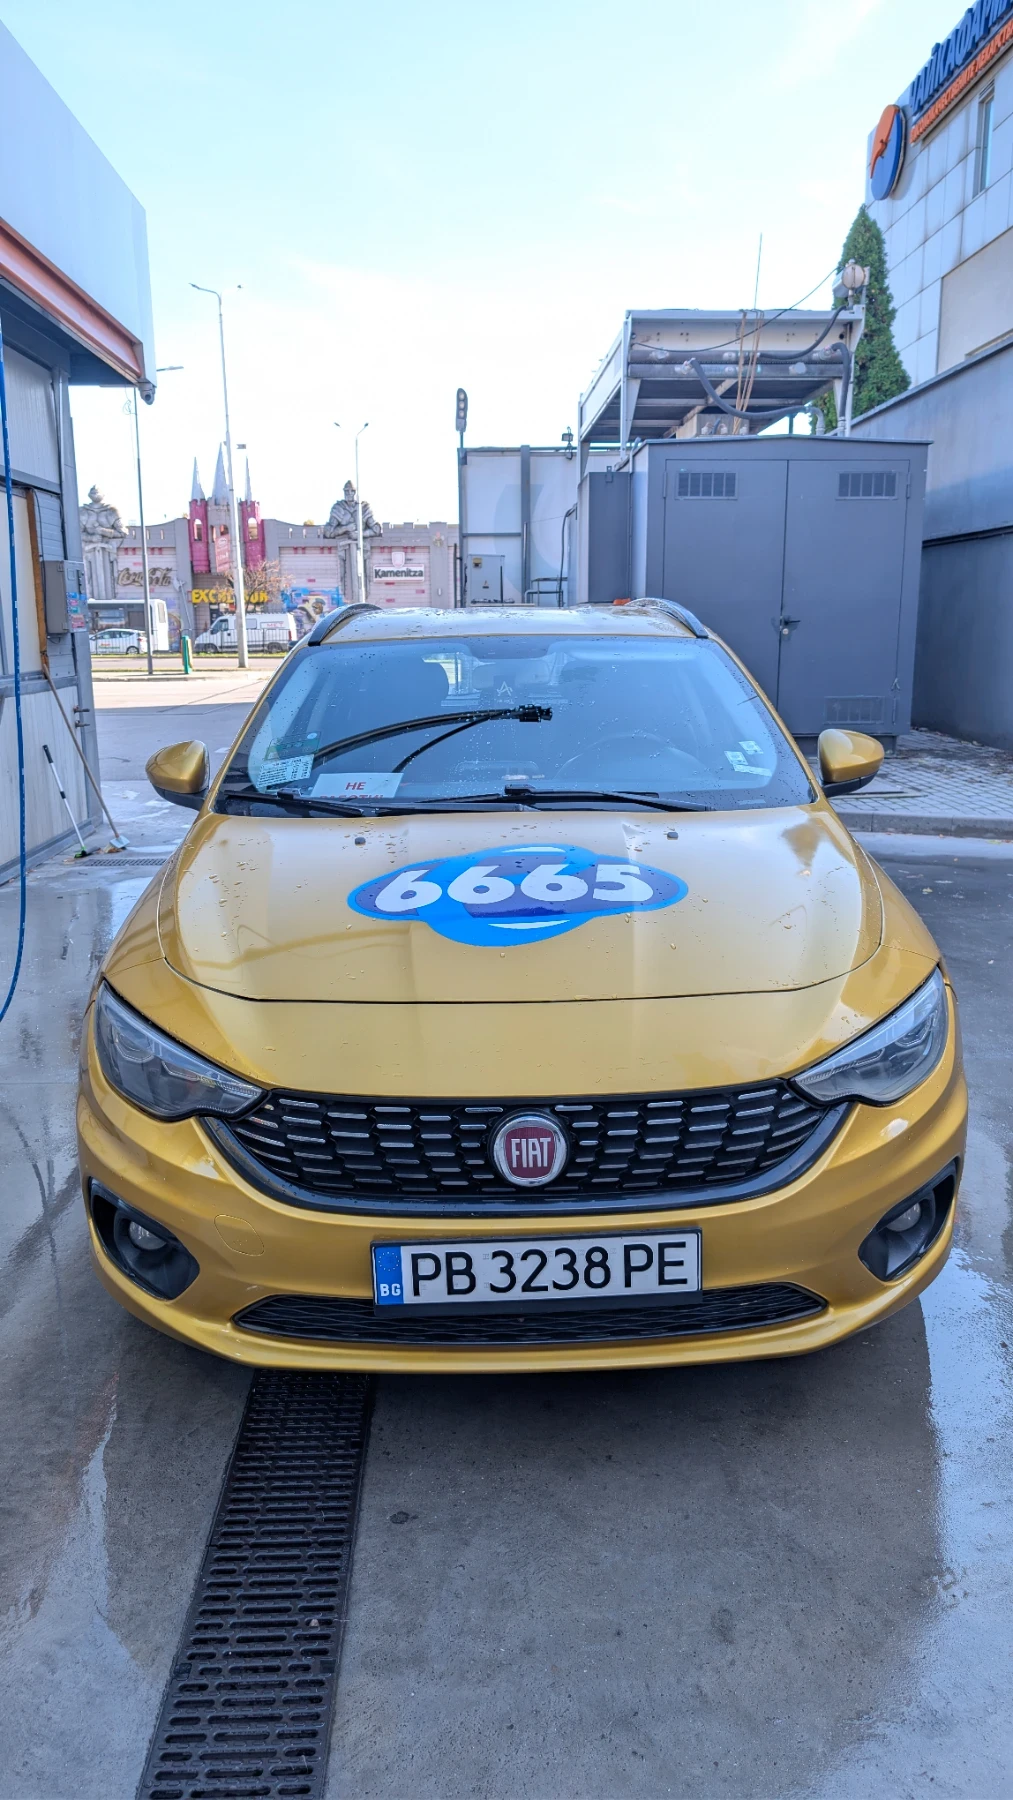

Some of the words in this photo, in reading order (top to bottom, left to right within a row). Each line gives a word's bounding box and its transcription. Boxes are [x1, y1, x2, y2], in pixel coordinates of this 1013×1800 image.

[374, 567, 424, 579] Kamenitza
[192, 588, 269, 604] EXCALUR
[345, 781, 367, 791] НЕ
[375, 864, 654, 913] 6665
[510, 1137, 552, 1169] FIAT
[410, 1251, 477, 1298] PB
[488, 1245, 612, 1294] 3238
[622, 1241, 689, 1289] PE
[379, 1283, 402, 1297] BG
